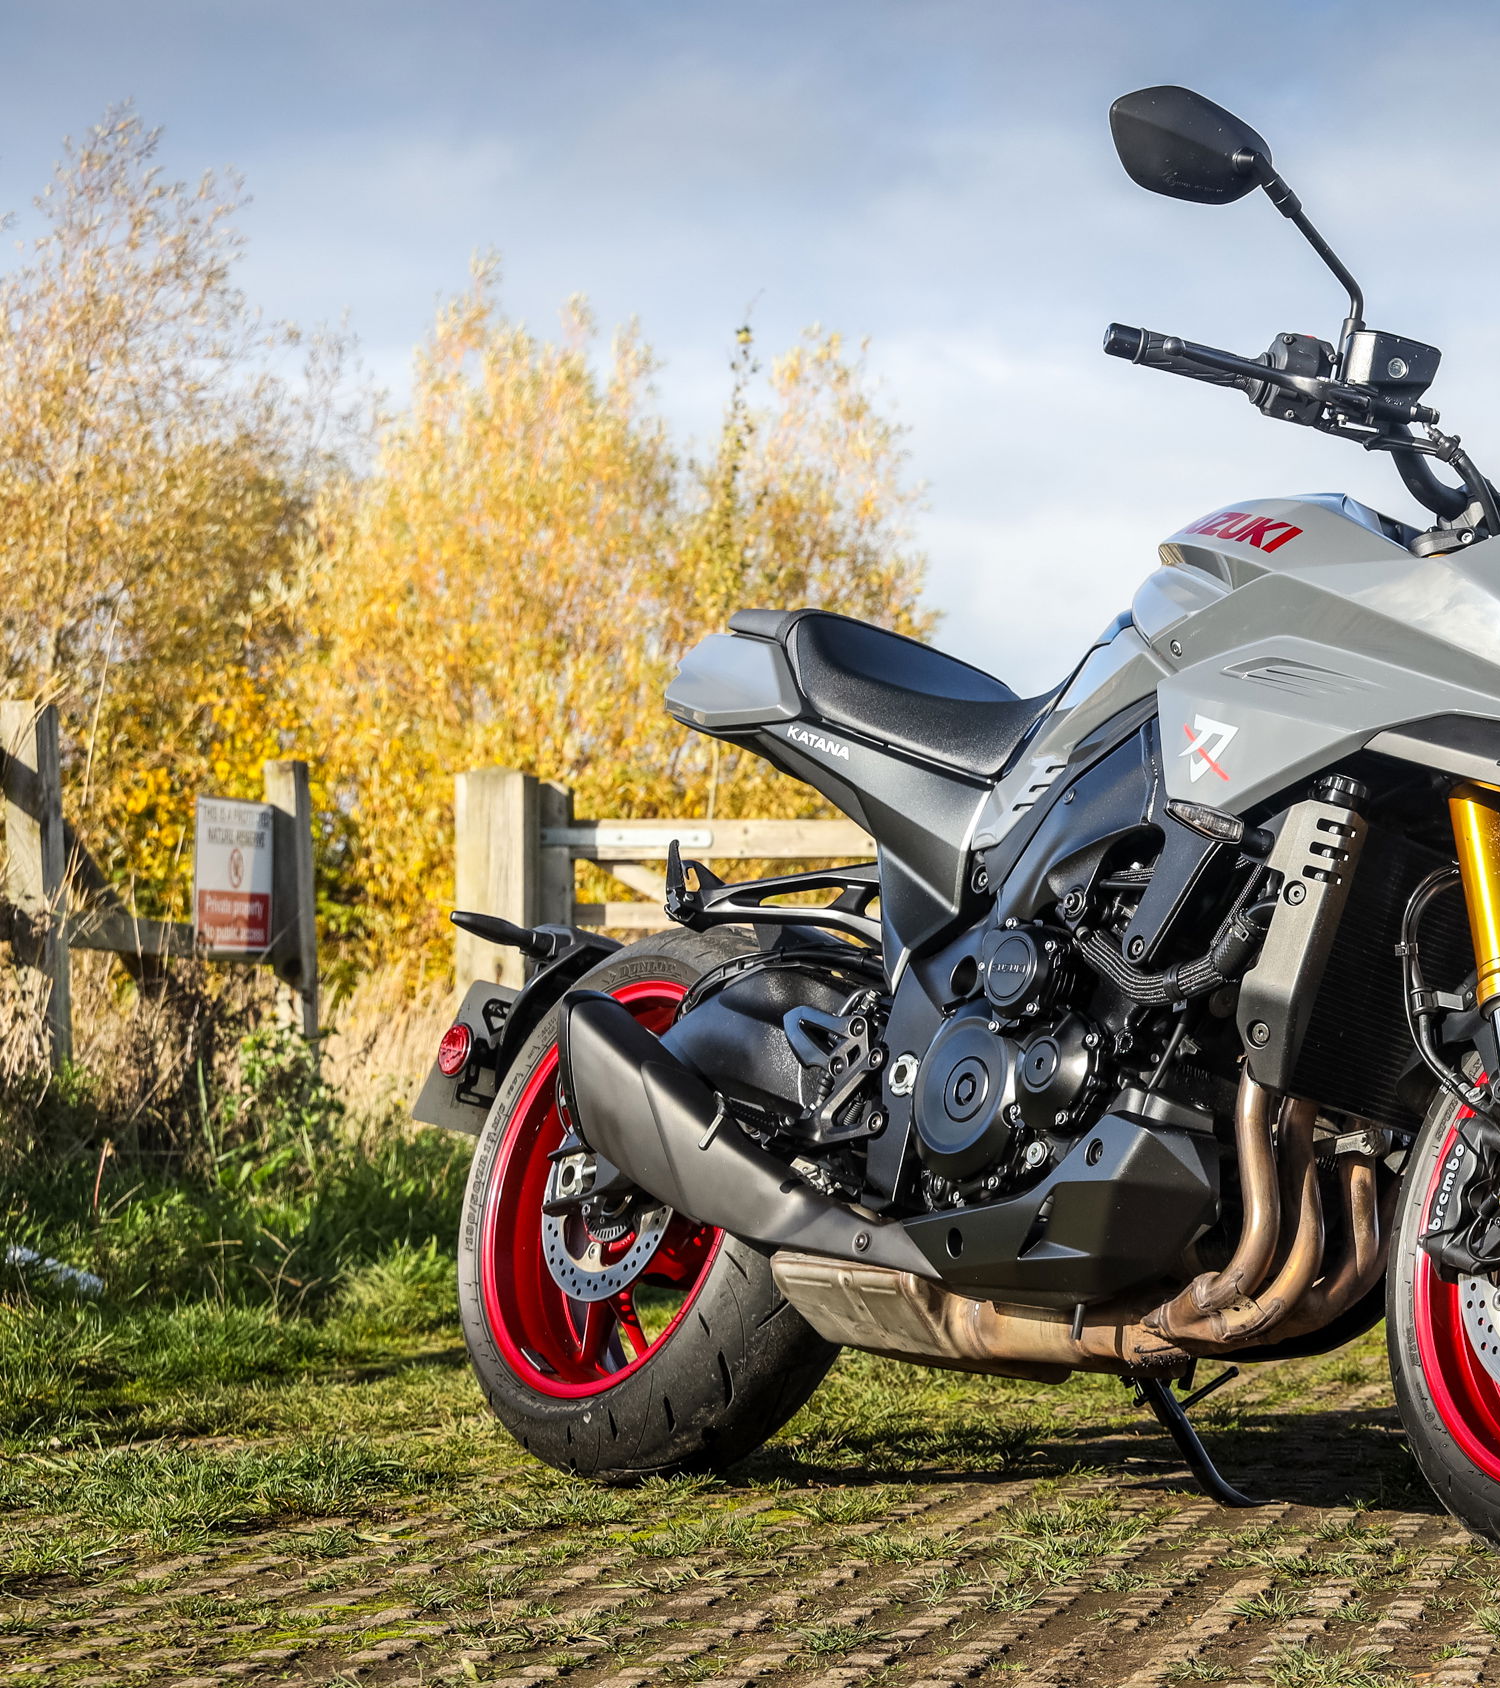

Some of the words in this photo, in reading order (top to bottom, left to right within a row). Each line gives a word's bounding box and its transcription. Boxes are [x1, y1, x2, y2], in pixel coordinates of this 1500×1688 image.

[1185, 511, 1303, 553] UZUKI
[787, 725, 849, 761] KATANA
[205, 894, 231, 914] Private
[621, 960, 677, 977] DUNLOP
[1428, 1143, 1466, 1231] brembo
